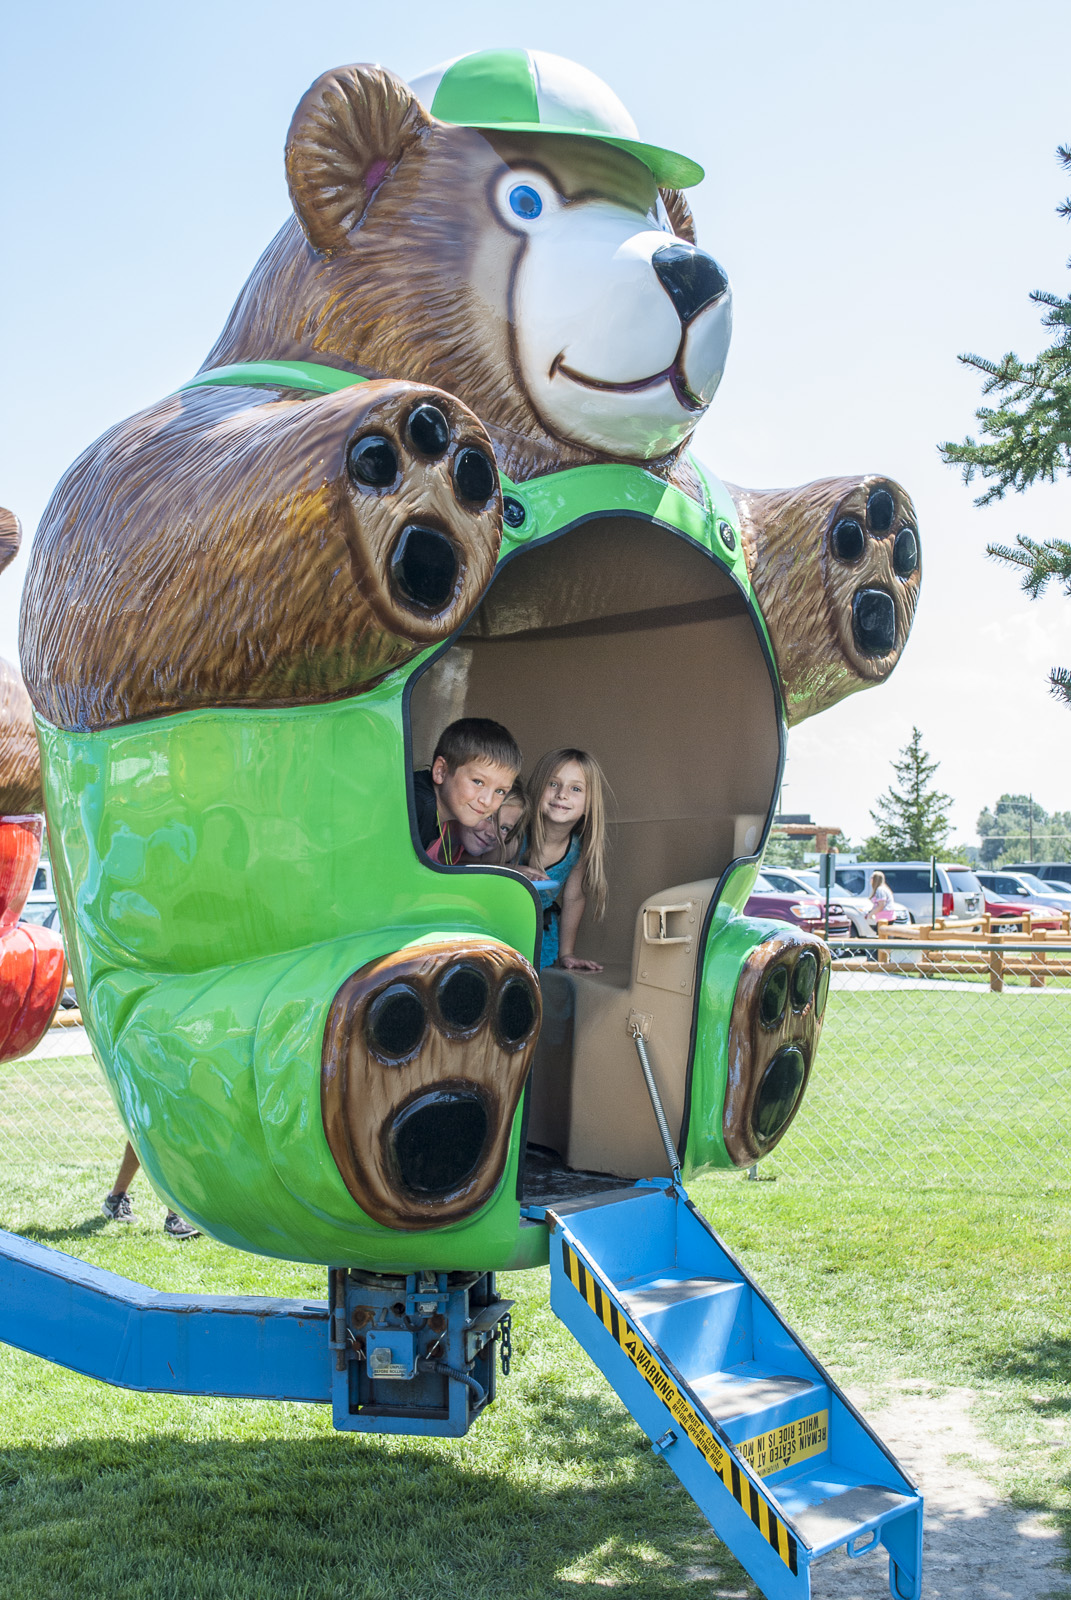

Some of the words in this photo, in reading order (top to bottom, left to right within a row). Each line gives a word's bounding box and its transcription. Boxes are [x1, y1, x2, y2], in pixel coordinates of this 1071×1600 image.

[636, 1349, 675, 1402] WARNING
[671, 1403, 689, 1427] BEFORE
[687, 1424, 711, 1458] OPERATING
[709, 1453, 722, 1469] RIDE
[676, 1399, 689, 1413] STEP
[687, 1412, 701, 1430] MUST
[700, 1428, 708, 1438] BE
[705, 1436, 724, 1461] CLOSED
[778, 1424, 795, 1444] RIDE
[798, 1415, 819, 1437] WHILE
[757, 1436, 765, 1453] IN
[768, 1432, 776, 1449] IS
[799, 1427, 827, 1451] REMAIN
[757, 1451, 766, 1468] AT
[769, 1439, 797, 1463] SEATED
